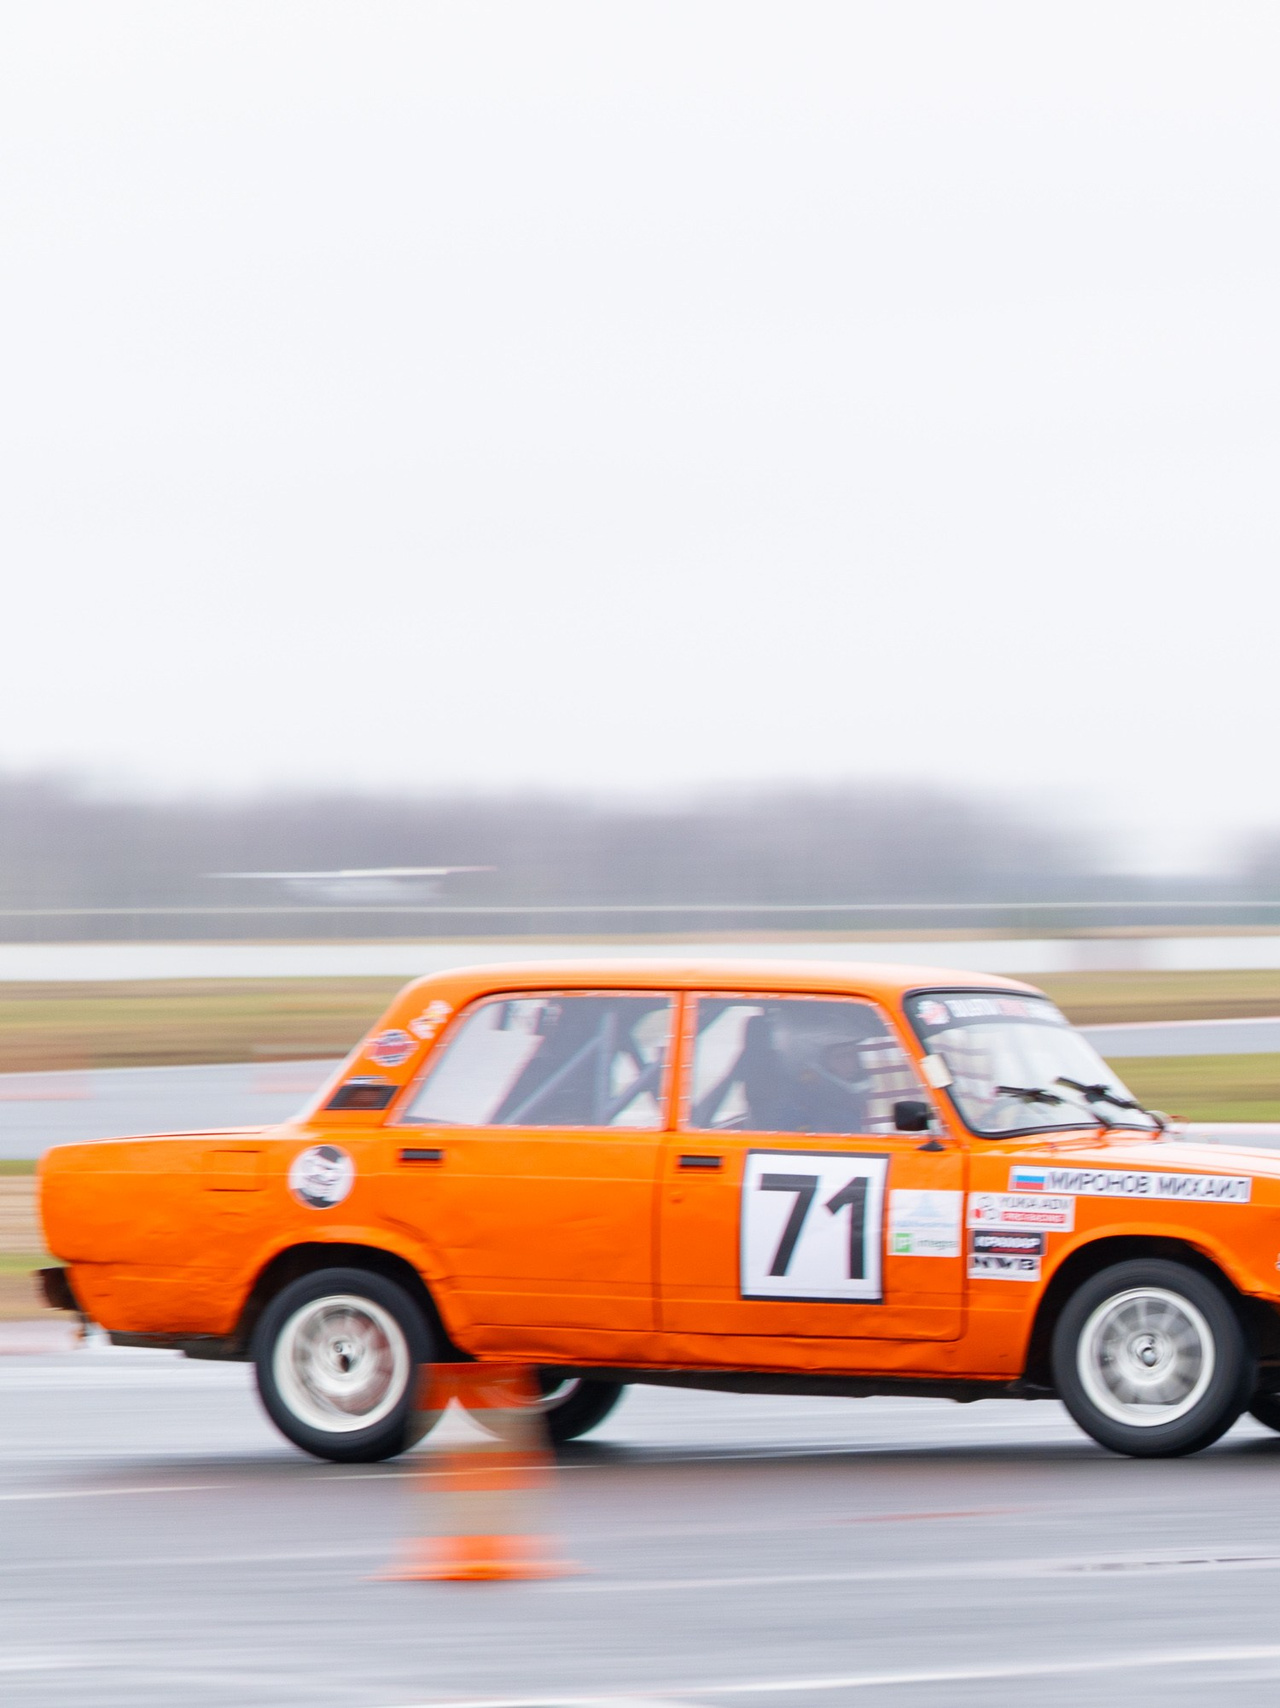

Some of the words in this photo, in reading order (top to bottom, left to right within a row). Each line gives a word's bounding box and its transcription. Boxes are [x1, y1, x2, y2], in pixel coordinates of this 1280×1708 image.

[1049, 1170, 1149, 1194] МИРОНОВ
[1156, 1176, 1249, 1199] МИХАИЛ
[759, 1173, 870, 1280] 71
